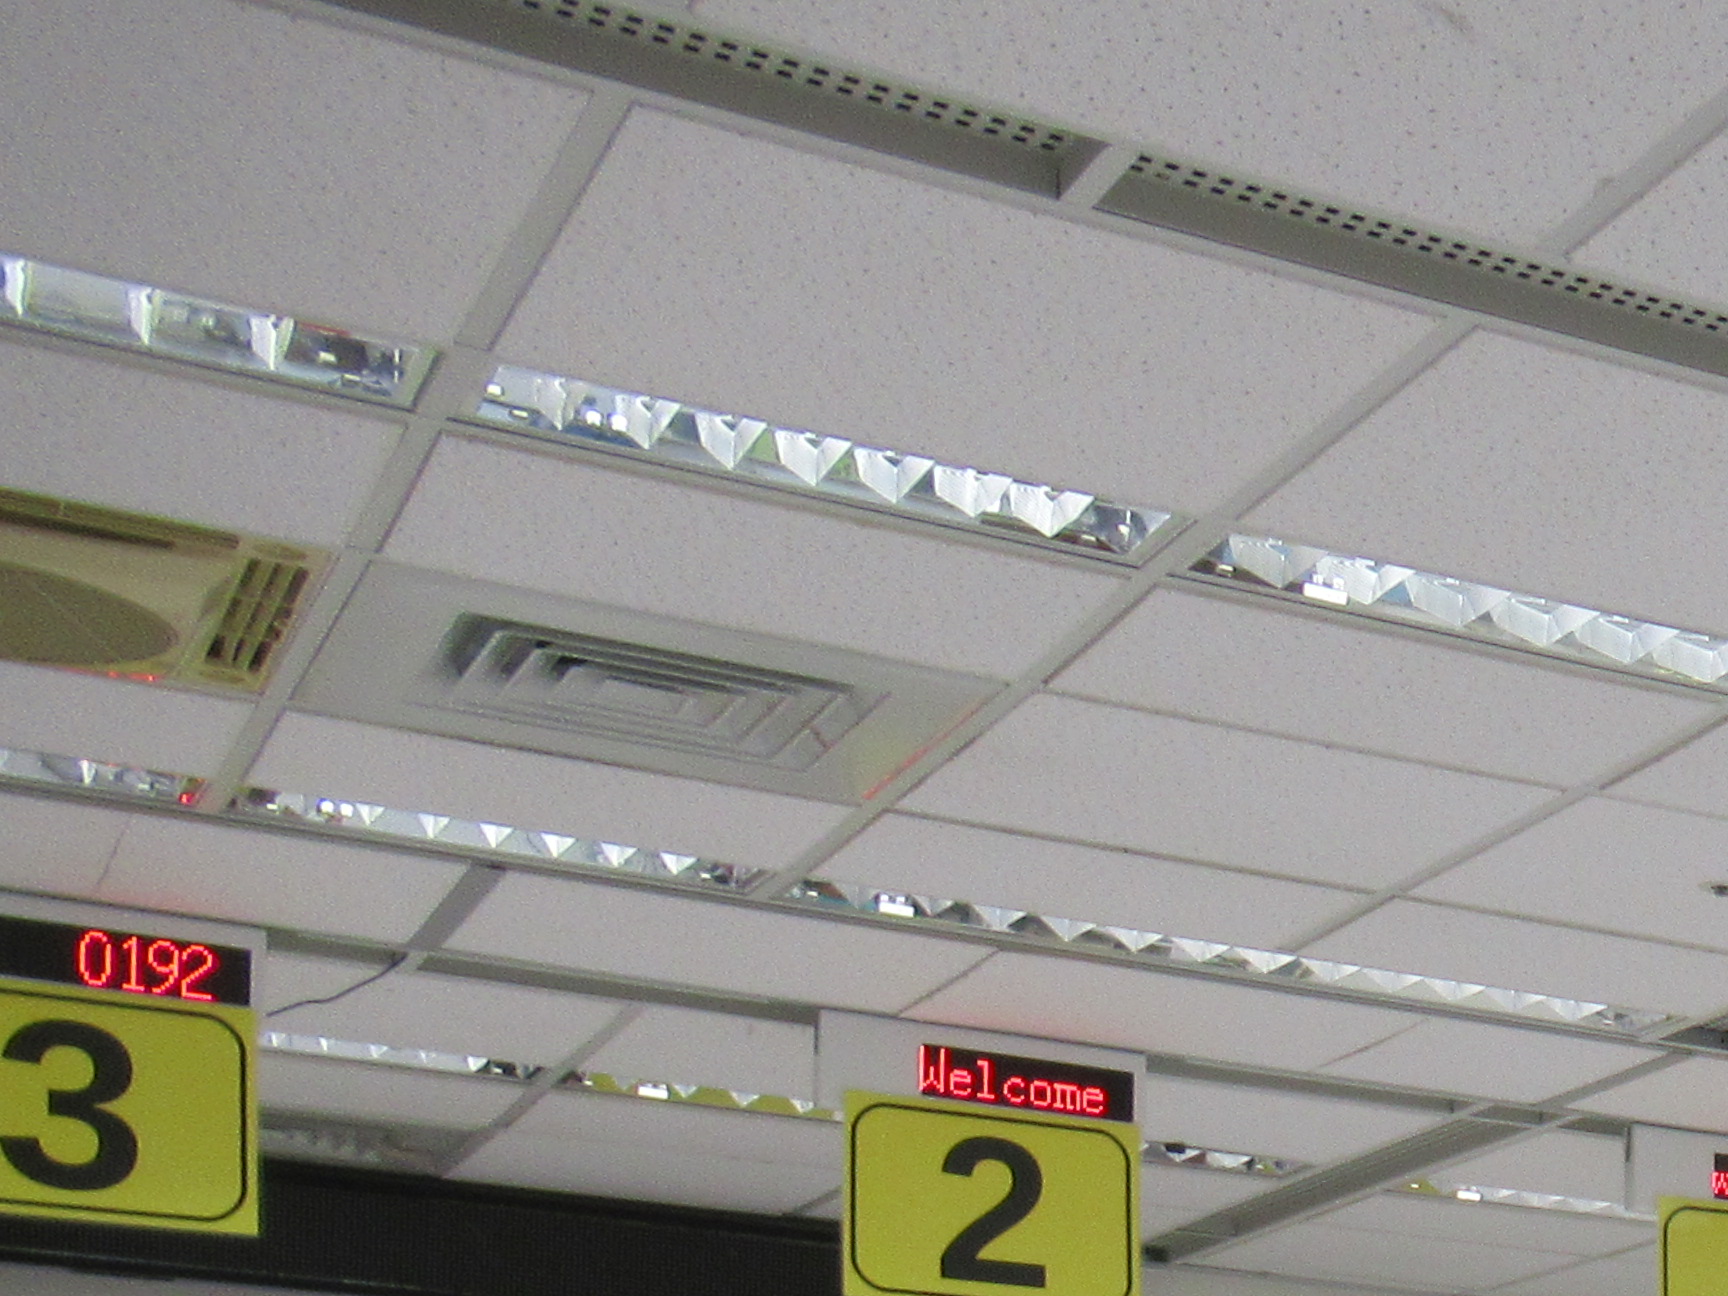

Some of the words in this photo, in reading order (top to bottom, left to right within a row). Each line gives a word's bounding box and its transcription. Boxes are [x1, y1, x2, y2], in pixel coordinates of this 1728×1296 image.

[76, 928, 219, 1003] 0192
[0, 1018, 139, 1191] 3
[916, 1043, 1108, 1116] Welcome
[939, 1135, 1047, 1289] 2
